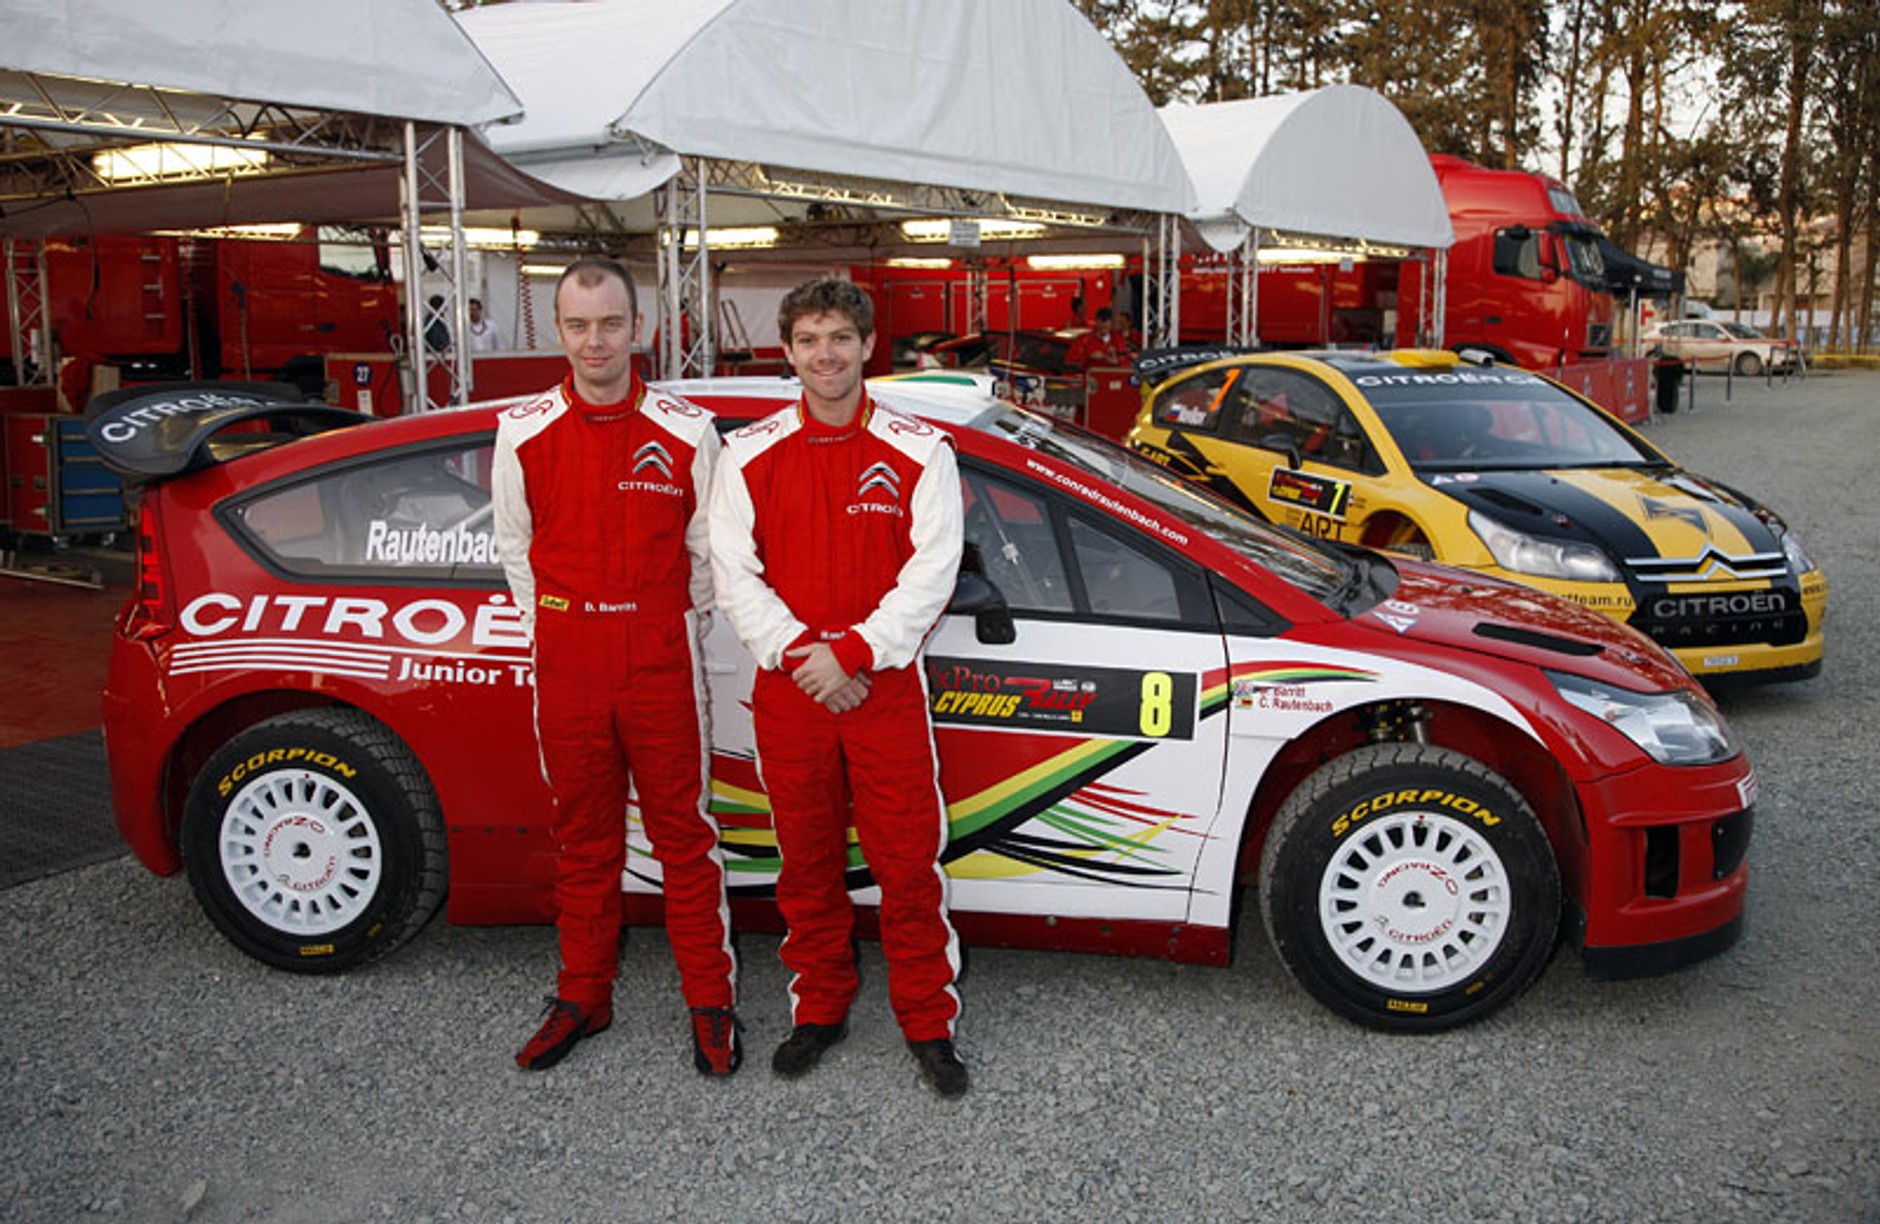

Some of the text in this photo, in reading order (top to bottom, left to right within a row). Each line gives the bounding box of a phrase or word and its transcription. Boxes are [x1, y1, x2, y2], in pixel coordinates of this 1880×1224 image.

[1139, 350, 1236, 369] CITRO
[1208, 368, 1241, 413] 1
[397, 657, 502, 685] Junior
[934, 690, 1022, 718] CYPRUS
[1140, 671, 1173, 737] 8
[217, 747, 357, 797] SCORPION
[1331, 788, 1501, 838] SCORPION
